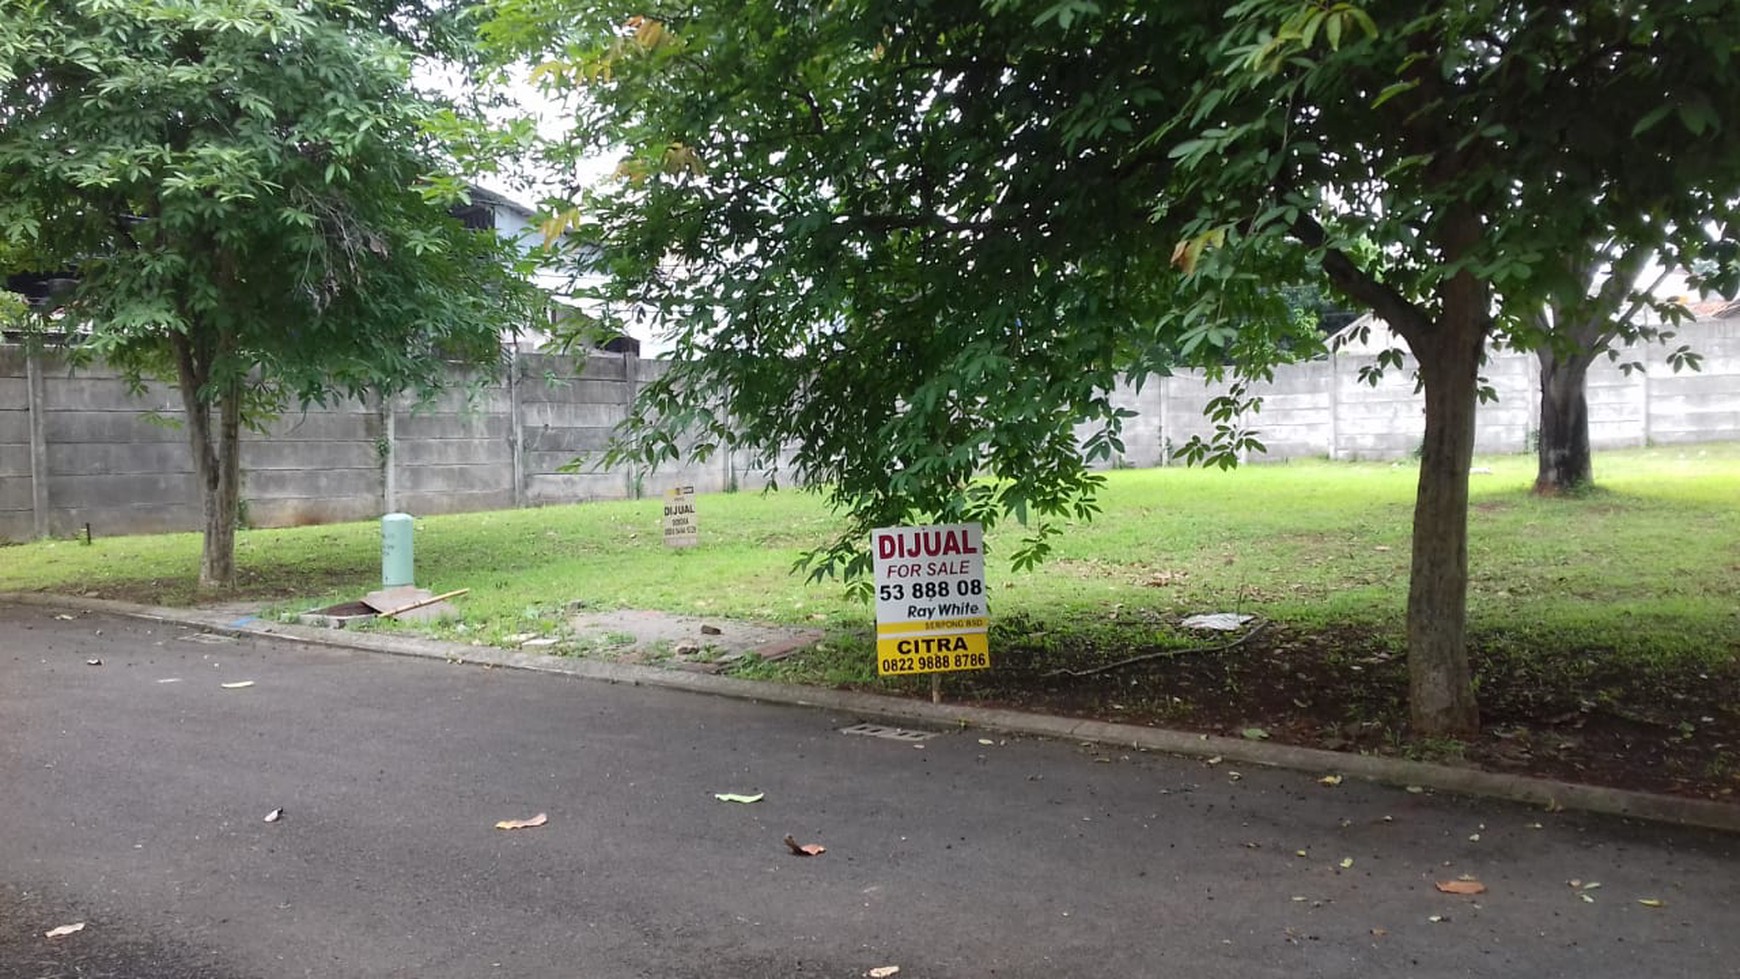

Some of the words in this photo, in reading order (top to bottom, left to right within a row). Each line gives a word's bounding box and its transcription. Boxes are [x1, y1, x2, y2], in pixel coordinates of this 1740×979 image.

[664, 504, 695, 516] DIJUAL
[878, 530, 978, 559] DIJUAL
[887, 564, 922, 578] FOR
[926, 560, 970, 577] SALE
[880, 584, 905, 601] 53
[912, 581, 950, 599] 888
[957, 579, 982, 596] 08
[907, 605, 936, 619] Ray
[938, 601, 979, 616] White
[897, 637, 968, 655] CITRA
[882, 658, 915, 672] 0822
[918, 655, 950, 670] 9888
[954, 653, 985, 668] 8786
